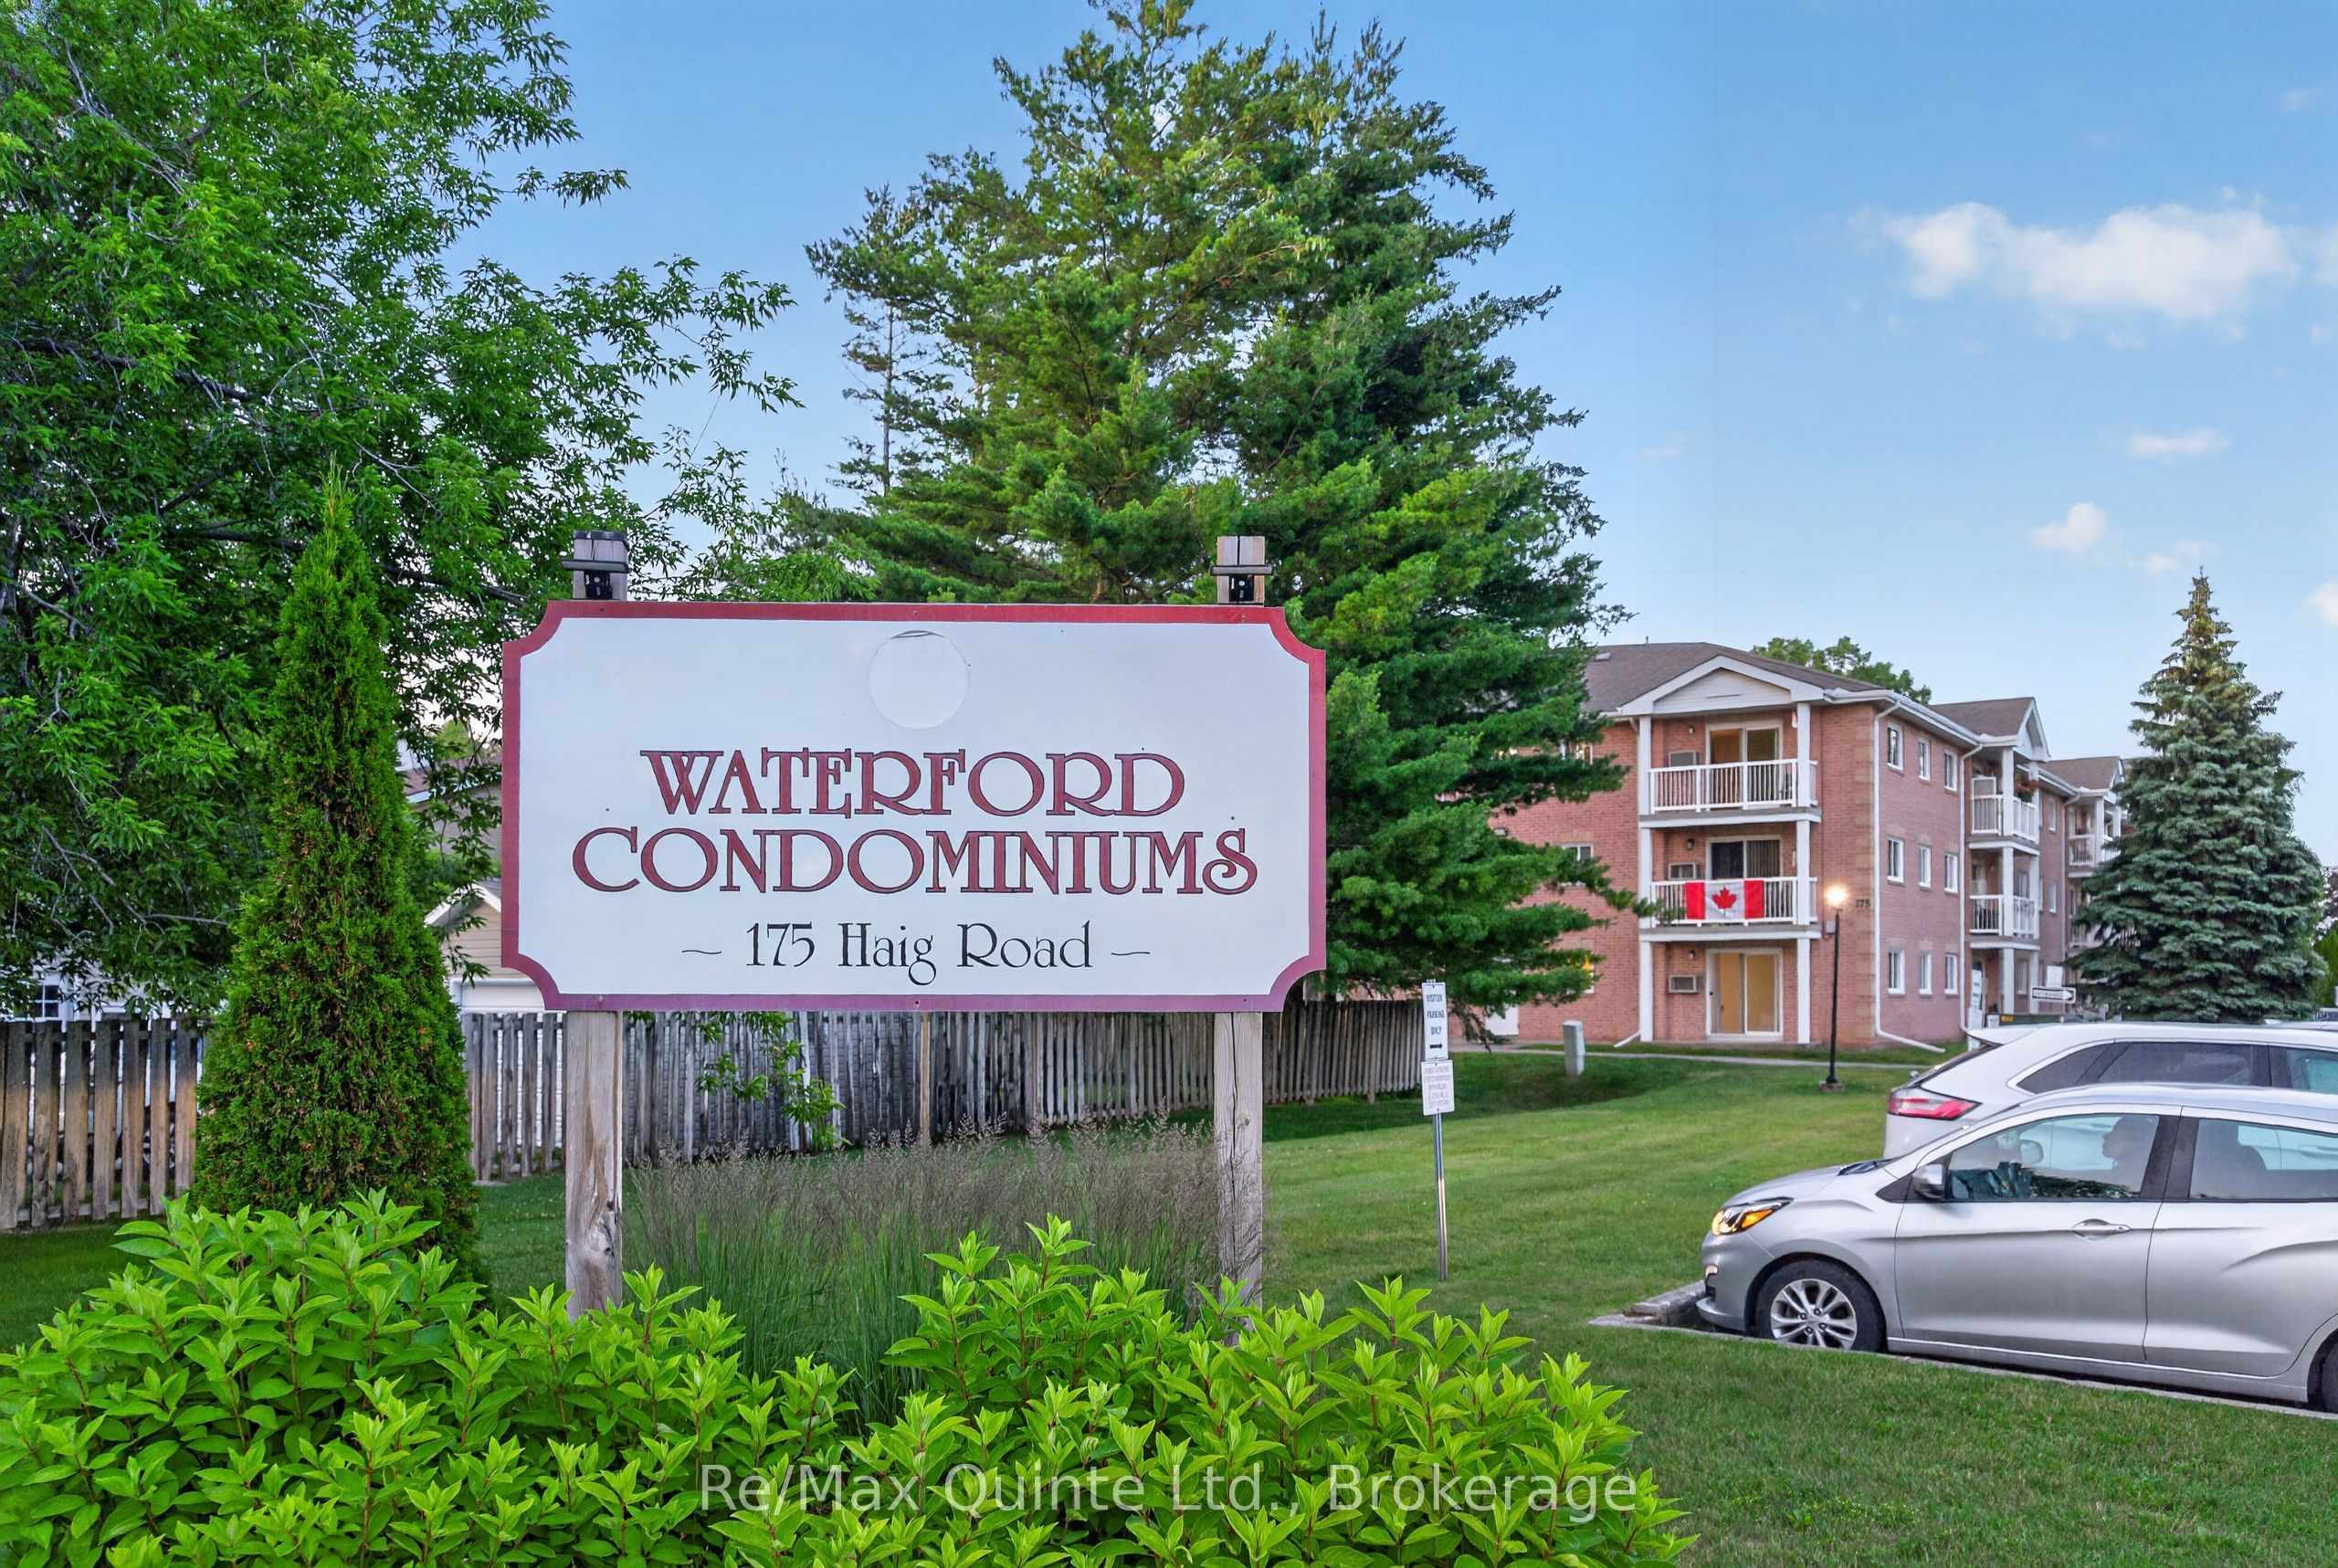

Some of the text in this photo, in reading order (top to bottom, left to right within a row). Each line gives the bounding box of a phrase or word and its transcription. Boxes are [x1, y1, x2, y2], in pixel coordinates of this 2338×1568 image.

[640, 747, 1185, 819] WATERFORD
[573, 826, 1258, 895] CONDOMINIUMS
[746, 921, 1092, 985] 175 Haig Road
[1427, 1010, 1445, 1019] PARKING
[1431, 1026, 1442, 1035] ONLY
